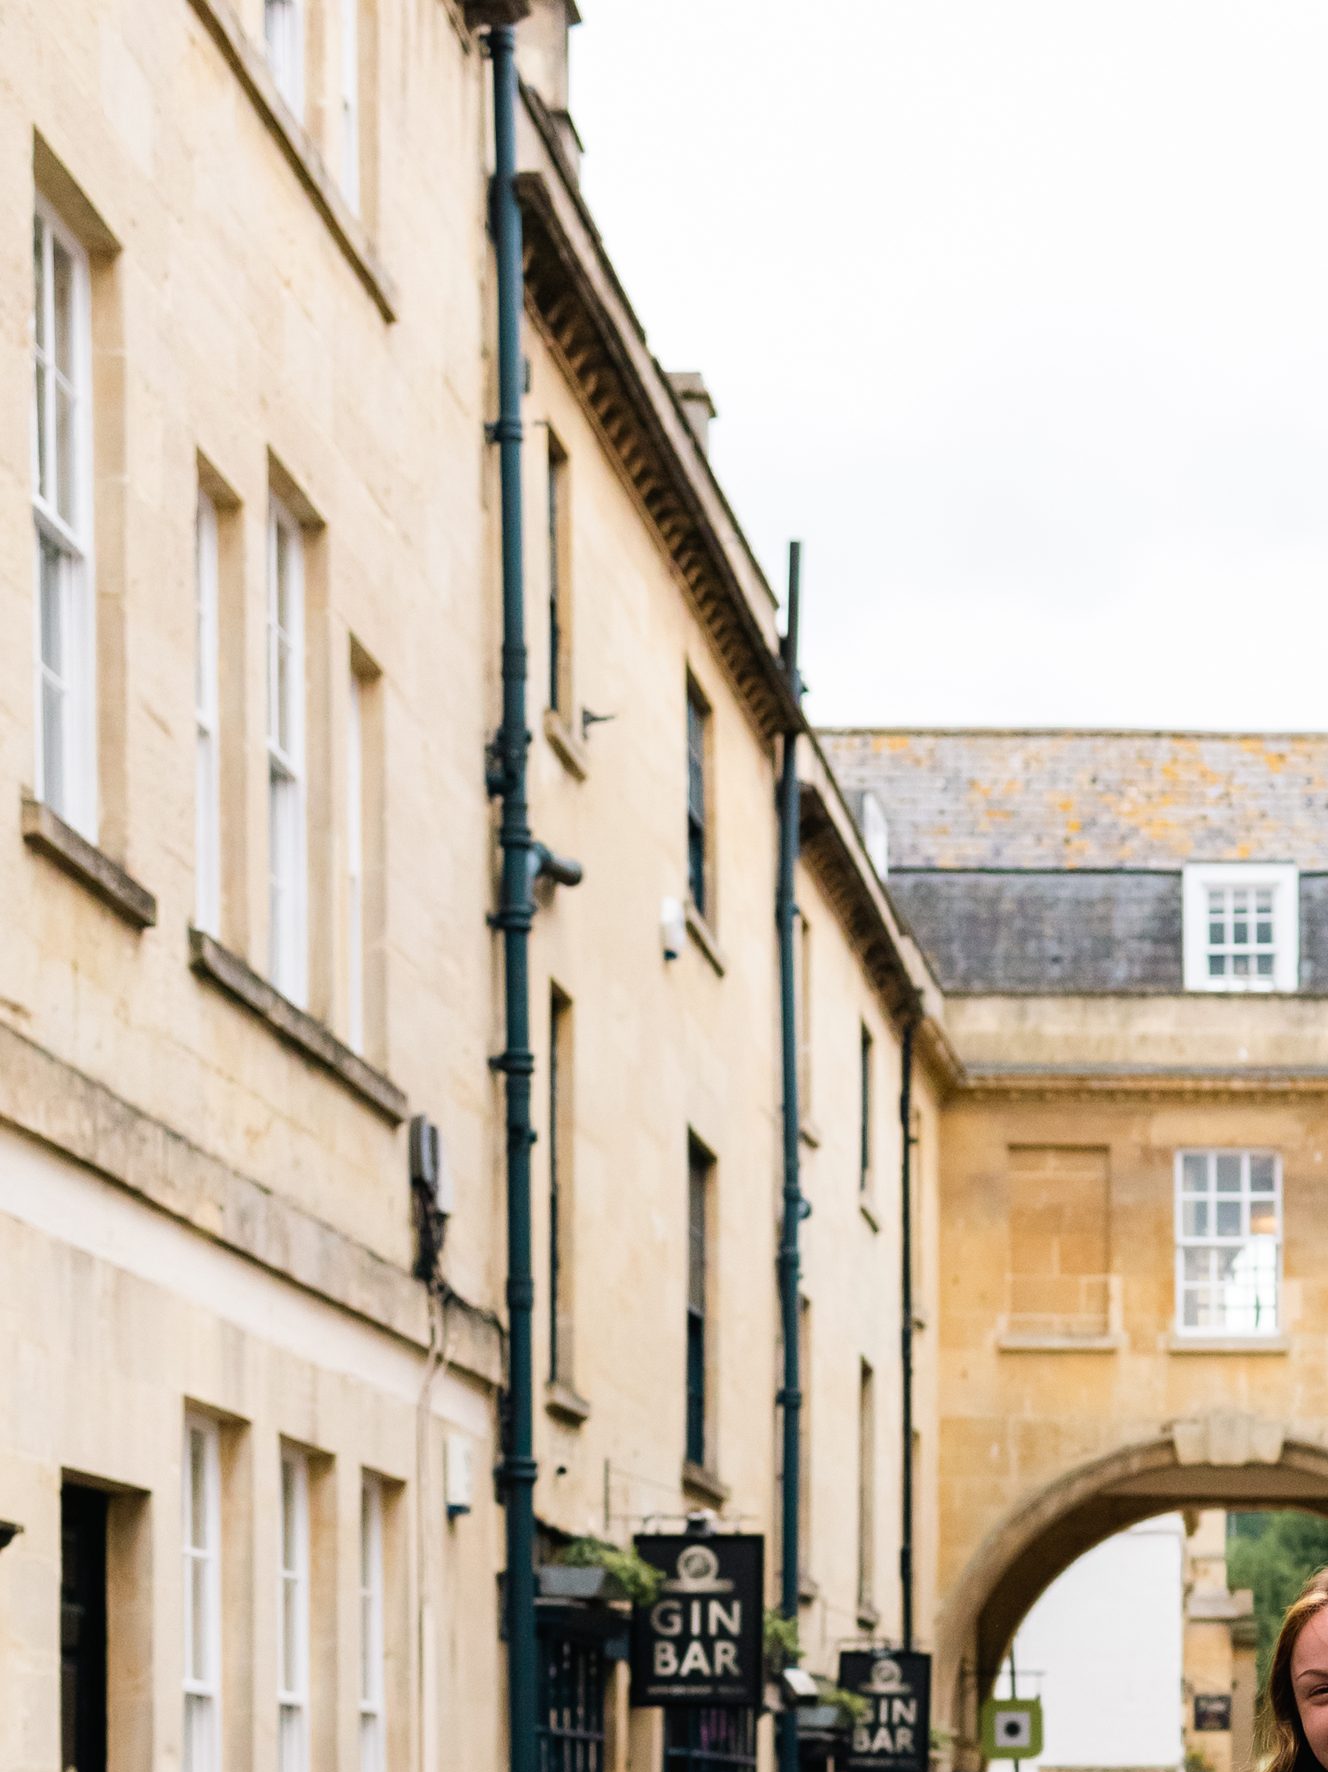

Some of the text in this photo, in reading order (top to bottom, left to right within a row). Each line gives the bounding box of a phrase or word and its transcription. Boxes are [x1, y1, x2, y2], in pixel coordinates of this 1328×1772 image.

[651, 1600, 741, 1636] GIN
[653, 1641, 740, 1677] BAR
[852, 1727, 915, 1753] BAR
